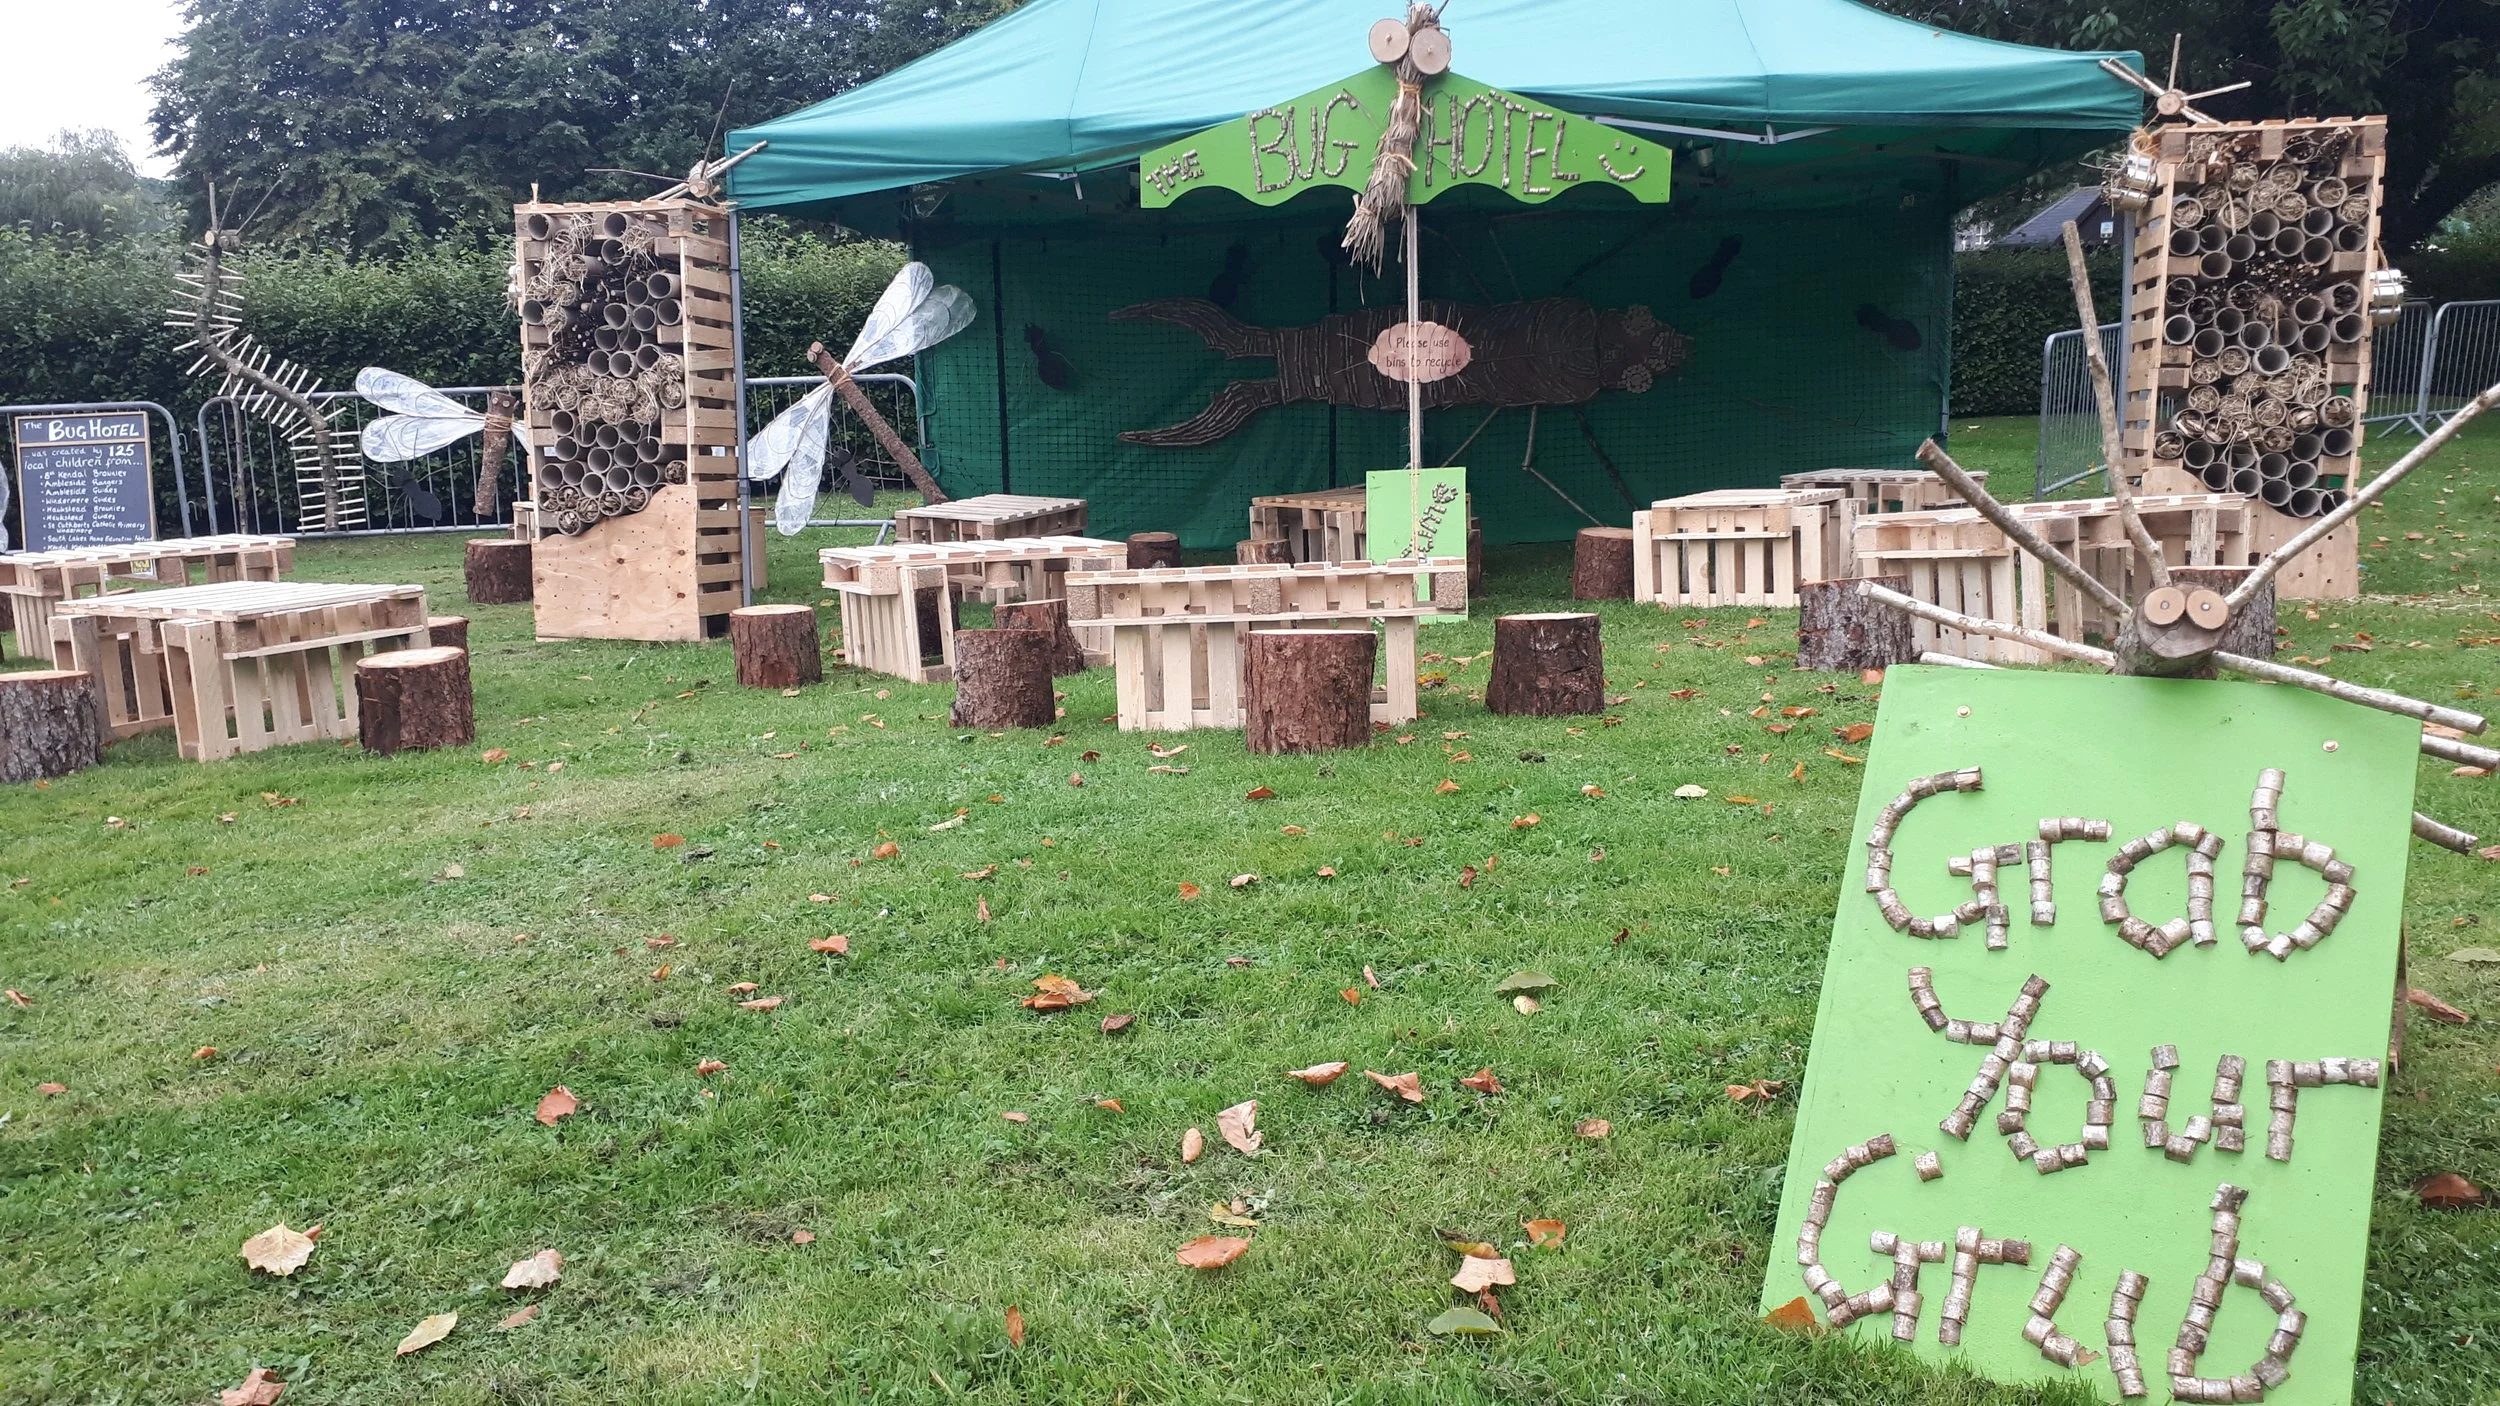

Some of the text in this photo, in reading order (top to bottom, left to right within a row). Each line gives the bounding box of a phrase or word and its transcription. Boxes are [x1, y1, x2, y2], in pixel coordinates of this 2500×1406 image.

[1145, 89, 1580, 197] THE BUG HOTEL
[1433, 338, 1449, 348] use
[1386, 355, 1406, 368] bins
[1425, 354, 1462, 374] recycle
[24, 421, 43, 430] The
[89, 418, 140, 438] HOTEL
[52, 447, 86, 456] created
[93, 447, 102, 458] by
[109, 444, 135, 457] 125
[24, 458, 48, 470] local
[56, 456, 101, 468] children
[58, 469, 87, 479] Kendal
[93, 469, 127, 477] Brownies
[44, 478, 123, 487] Ambleside Rangers
[45, 486, 118, 496] Ambleside Guides
[46, 496, 116, 505] Windermere Guides
[46, 505, 87, 513] Hawkshead
[1866, 766, 2356, 961] Grab
[1908, 966, 2380, 1175] Your
[1797, 1132, 2307, 1404] Grub
